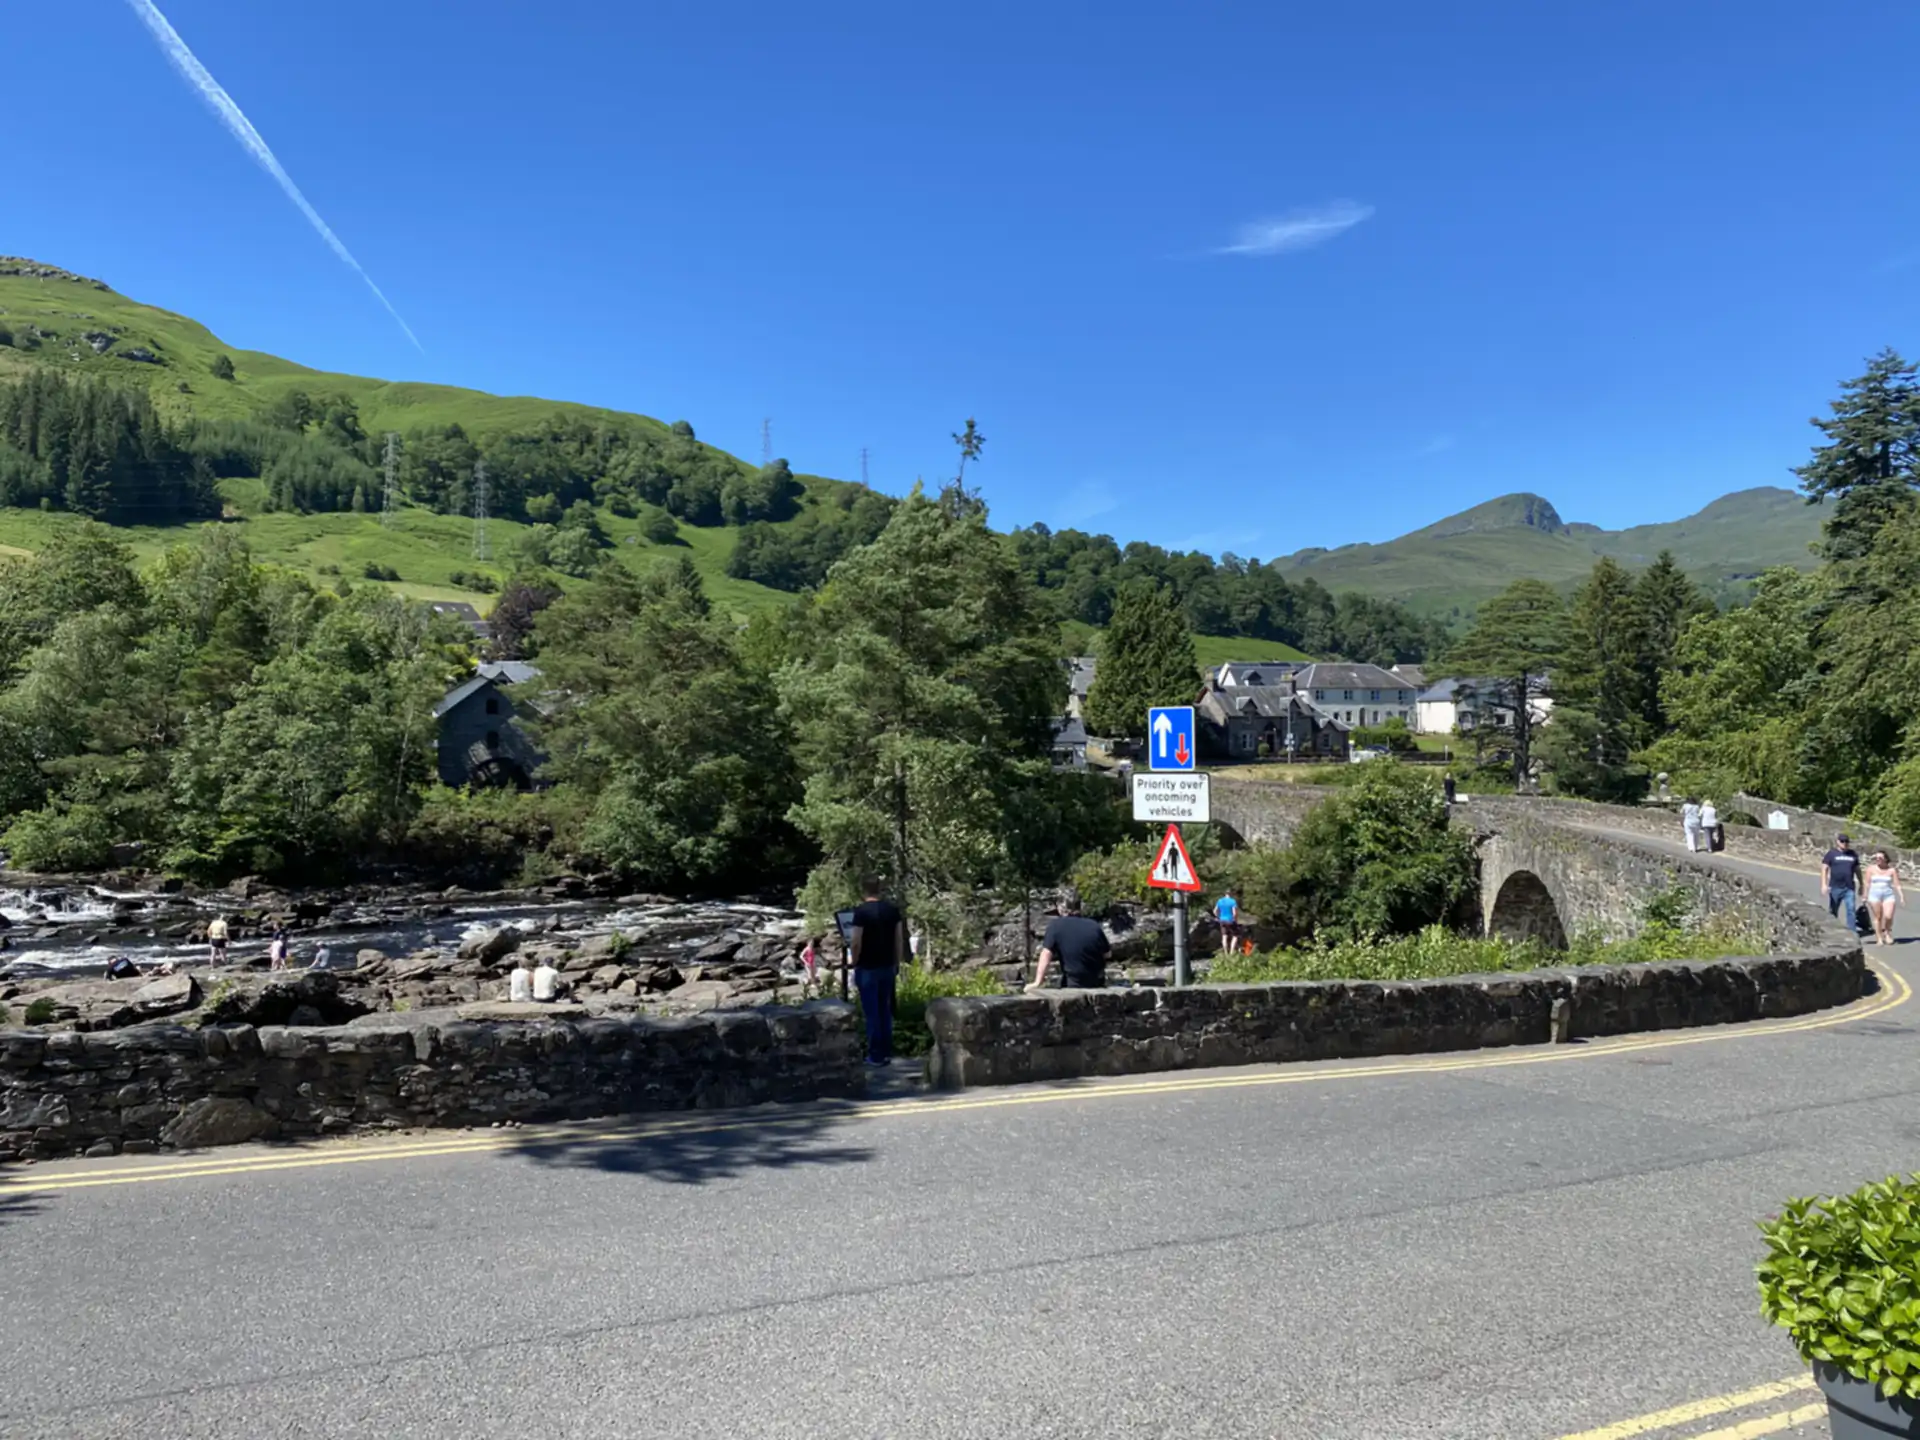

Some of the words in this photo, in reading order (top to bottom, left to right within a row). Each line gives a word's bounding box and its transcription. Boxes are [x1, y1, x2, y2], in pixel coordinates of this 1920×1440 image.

[1137, 778, 1176, 791] Priority
[1180, 780, 1203, 789] over
[1144, 793, 1196, 804] oncoming
[1149, 805, 1193, 817] vehicles
